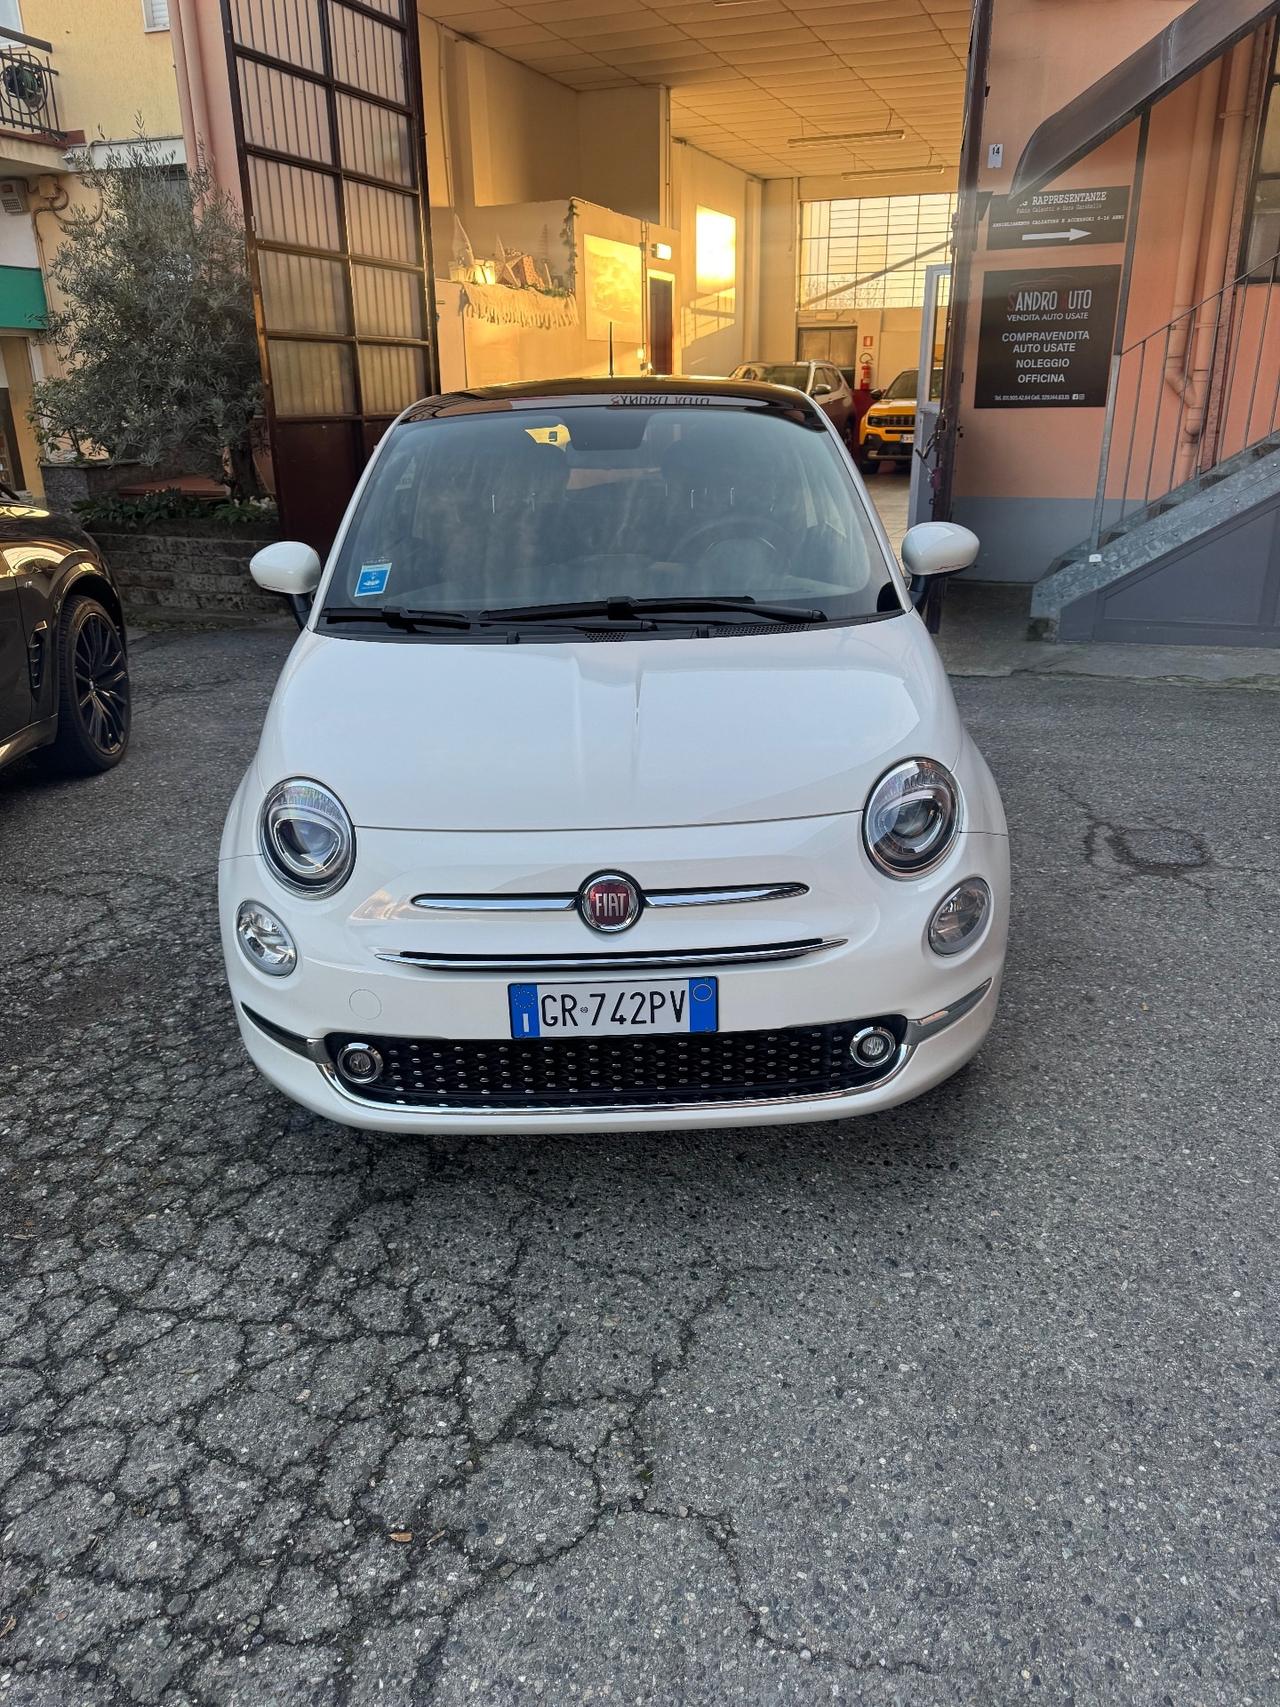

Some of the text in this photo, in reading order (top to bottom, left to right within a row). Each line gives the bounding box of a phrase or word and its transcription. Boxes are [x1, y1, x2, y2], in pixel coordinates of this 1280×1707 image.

[992, 146, 1000, 155] 14
[1032, 191, 1107, 205] RAPPRESENTANZE
[1008, 291, 1058, 312] SANDRO
[1007, 312, 1089, 322] VENDITA AUTO USATE
[1002, 331, 1090, 342] COMPRAVENDITA
[1013, 342, 1076, 353] AUTO USATE
[1016, 358, 1070, 368] NOLEGGIO
[1018, 374, 1066, 383] OFFICINA
[595, 893, 627, 917] FIAT
